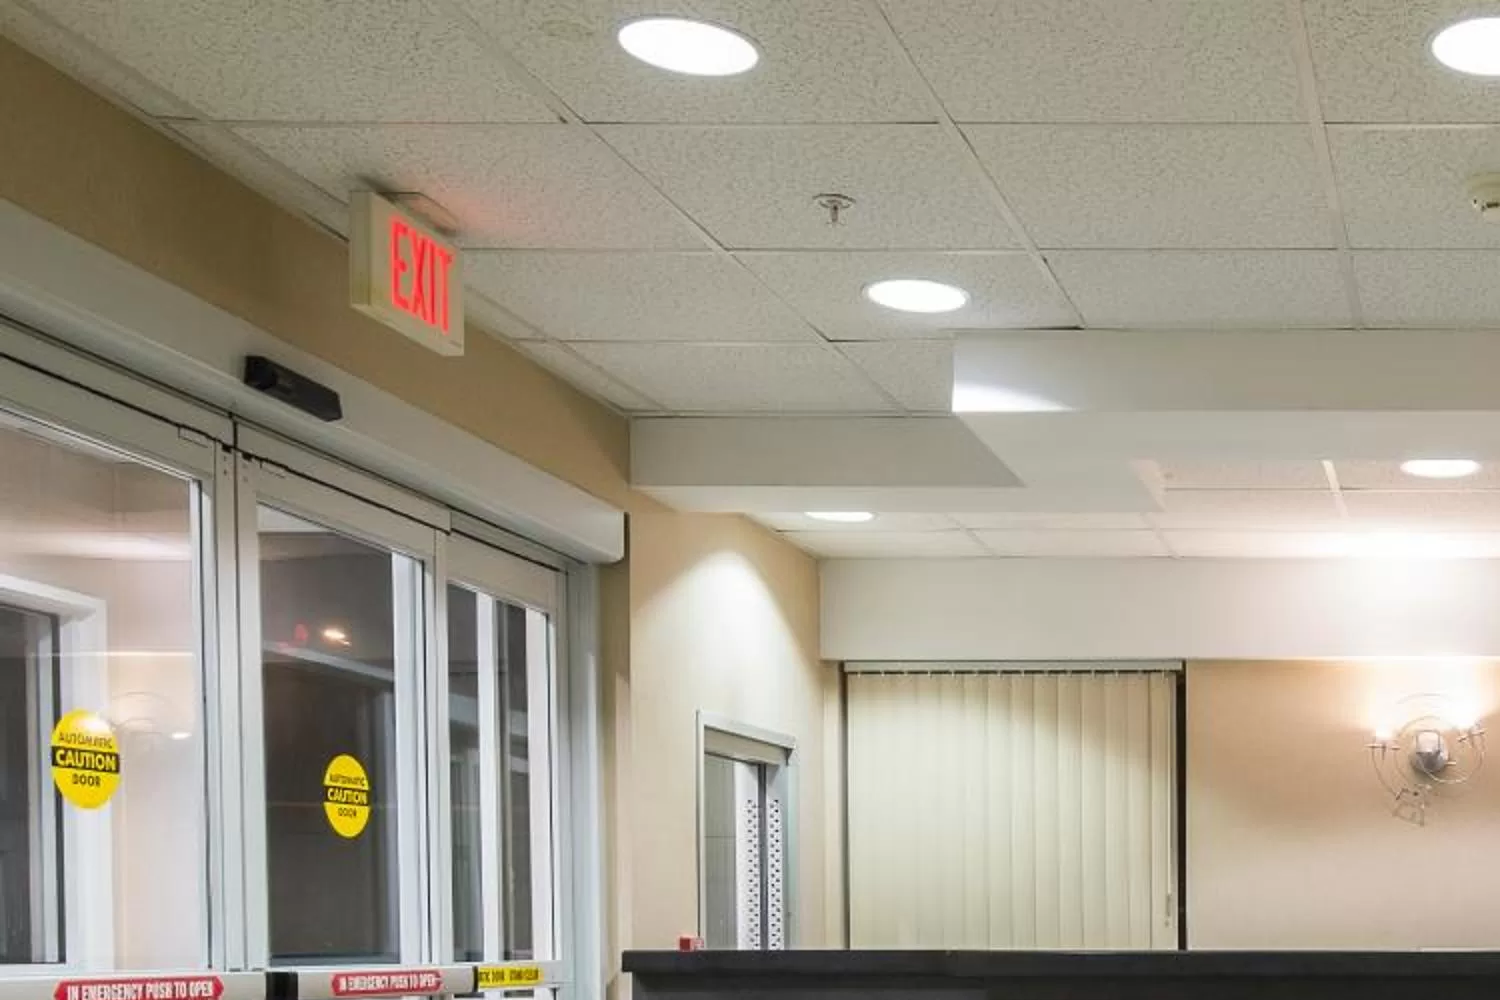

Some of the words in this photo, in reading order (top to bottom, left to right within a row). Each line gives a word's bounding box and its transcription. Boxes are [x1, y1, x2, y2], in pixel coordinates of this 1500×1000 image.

[391, 221, 455, 334] EXIT
[55, 749, 116, 771] CAUTION
[72, 773, 101, 787] DOOR
[327, 787, 367, 805] CAUTION
[145, 982, 174, 999] PUSH
[174, 981, 187, 998] TO
[189, 981, 214, 998] OPEN
